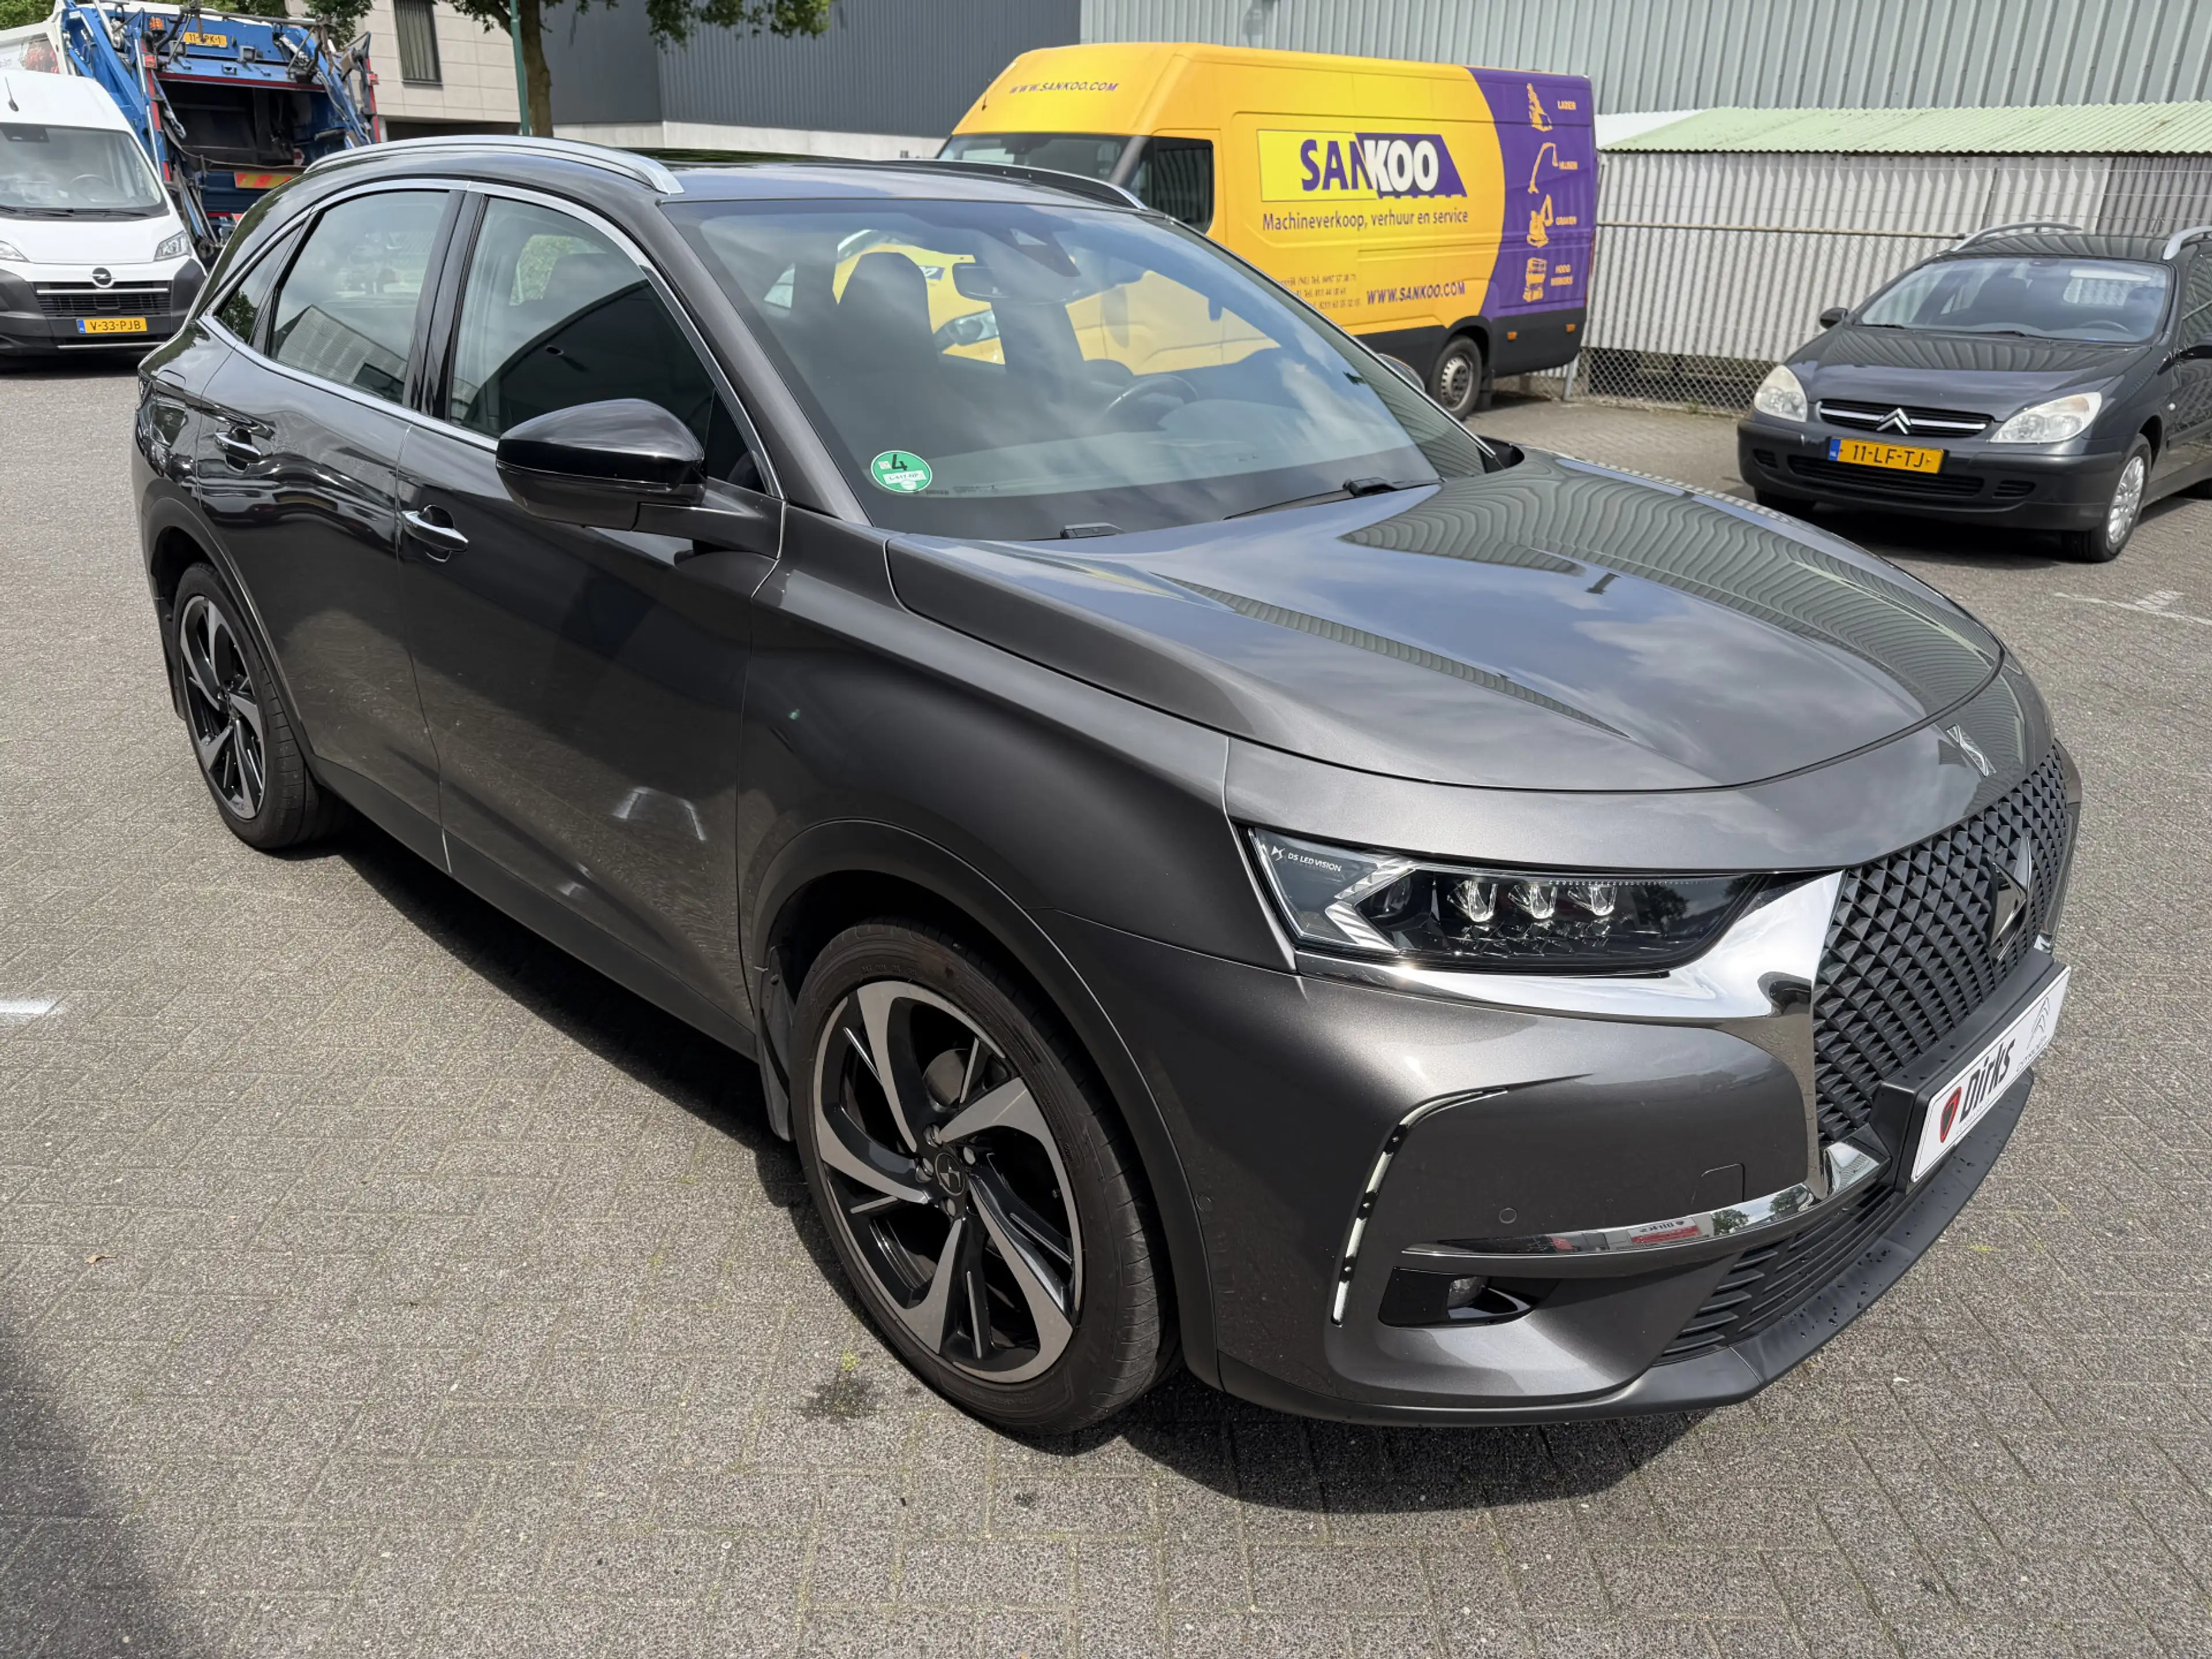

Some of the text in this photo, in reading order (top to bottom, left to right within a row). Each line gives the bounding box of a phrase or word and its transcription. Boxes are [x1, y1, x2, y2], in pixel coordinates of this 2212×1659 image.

[1300, 139, 1439, 192] SANKOO
[1263, 207, 1468, 231] Machineverkoop, verhuur en service
[1366, 281, 1465, 305] WWW.SANKOO.COM
[90, 320, 141, 331] V-33-PJB
[892, 454, 908, 471] 4
[1853, 445, 1925, 468] 11-LF-TJ
[1288, 852, 1342, 872] DS LED VISION
[1959, 1038, 2016, 1124] Dirks
